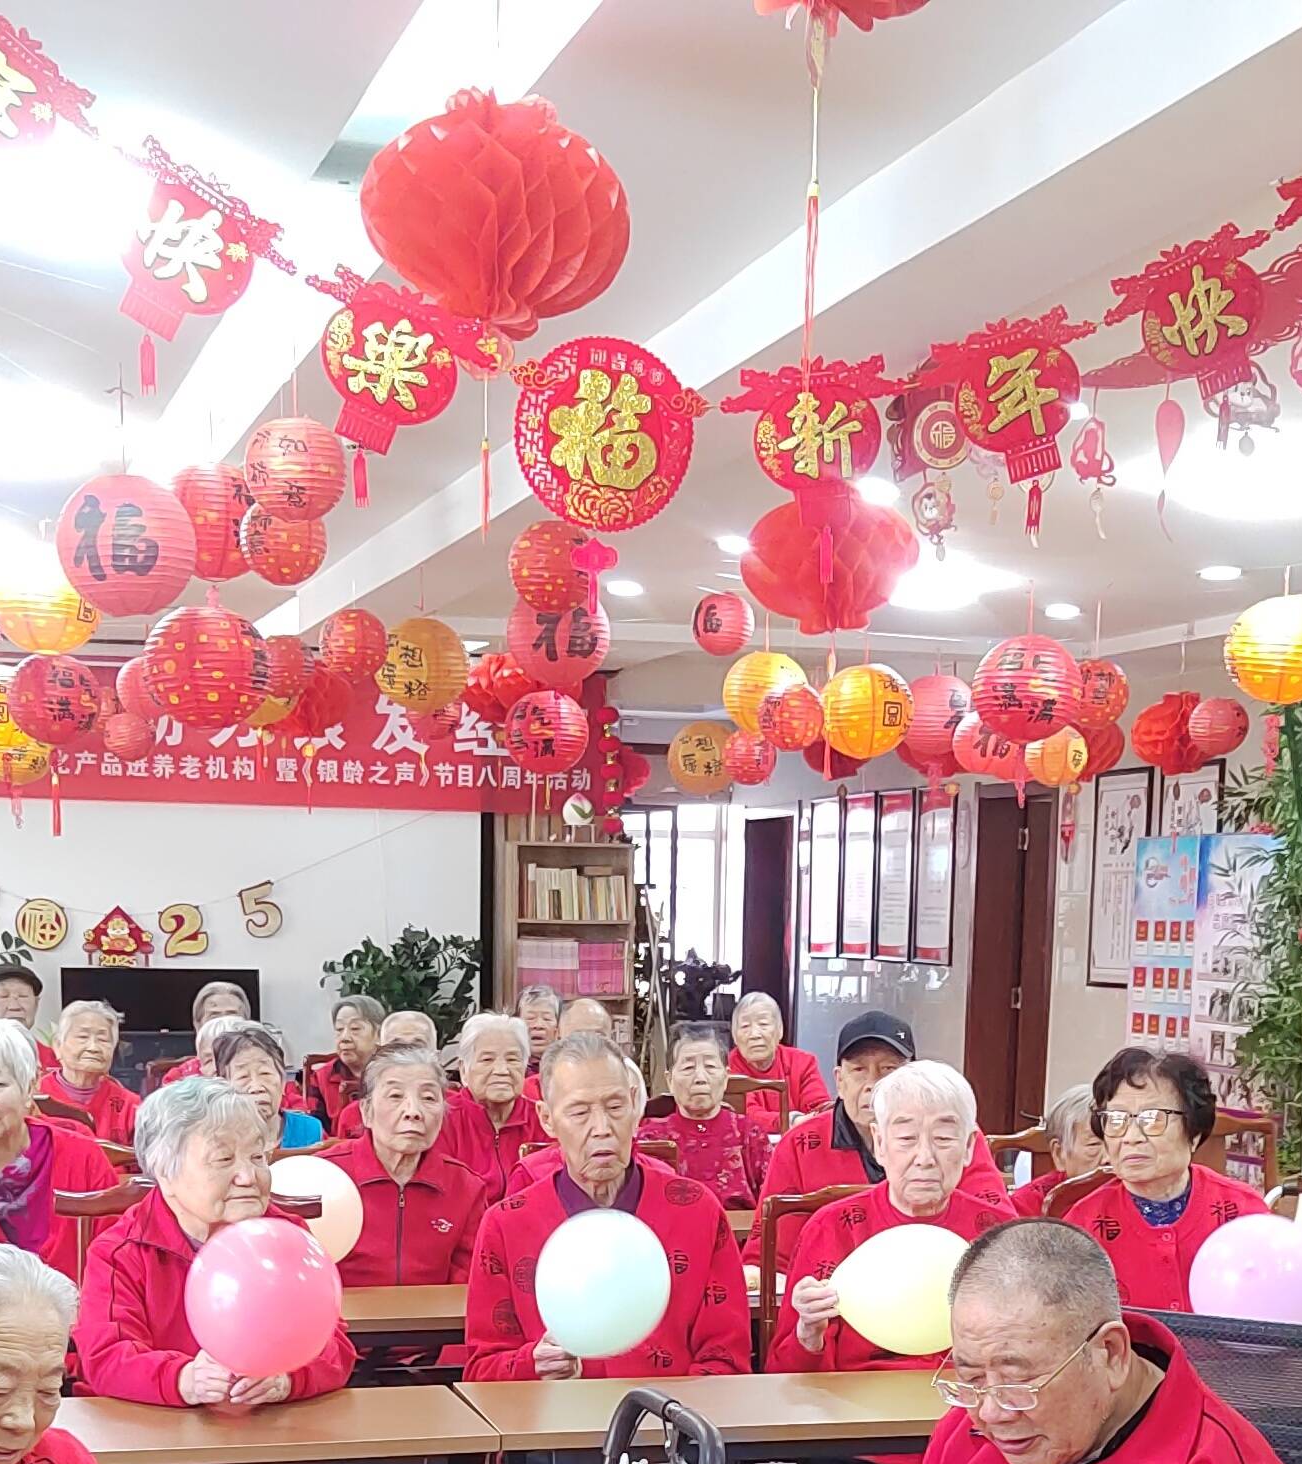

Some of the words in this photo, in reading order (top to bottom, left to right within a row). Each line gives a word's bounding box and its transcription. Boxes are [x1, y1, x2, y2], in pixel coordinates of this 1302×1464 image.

[137, 200, 224, 304] 快
[1161, 264, 1250, 356] 快
[549, 369, 657, 490] 福
[778, 392, 863, 478] 新
[987, 347, 1060, 436] 年
[73, 495, 159, 582] 福
[532, 607, 597, 661] 福
[238, 880, 283, 938] 5
[1093, 1214, 1121, 1240] 福
